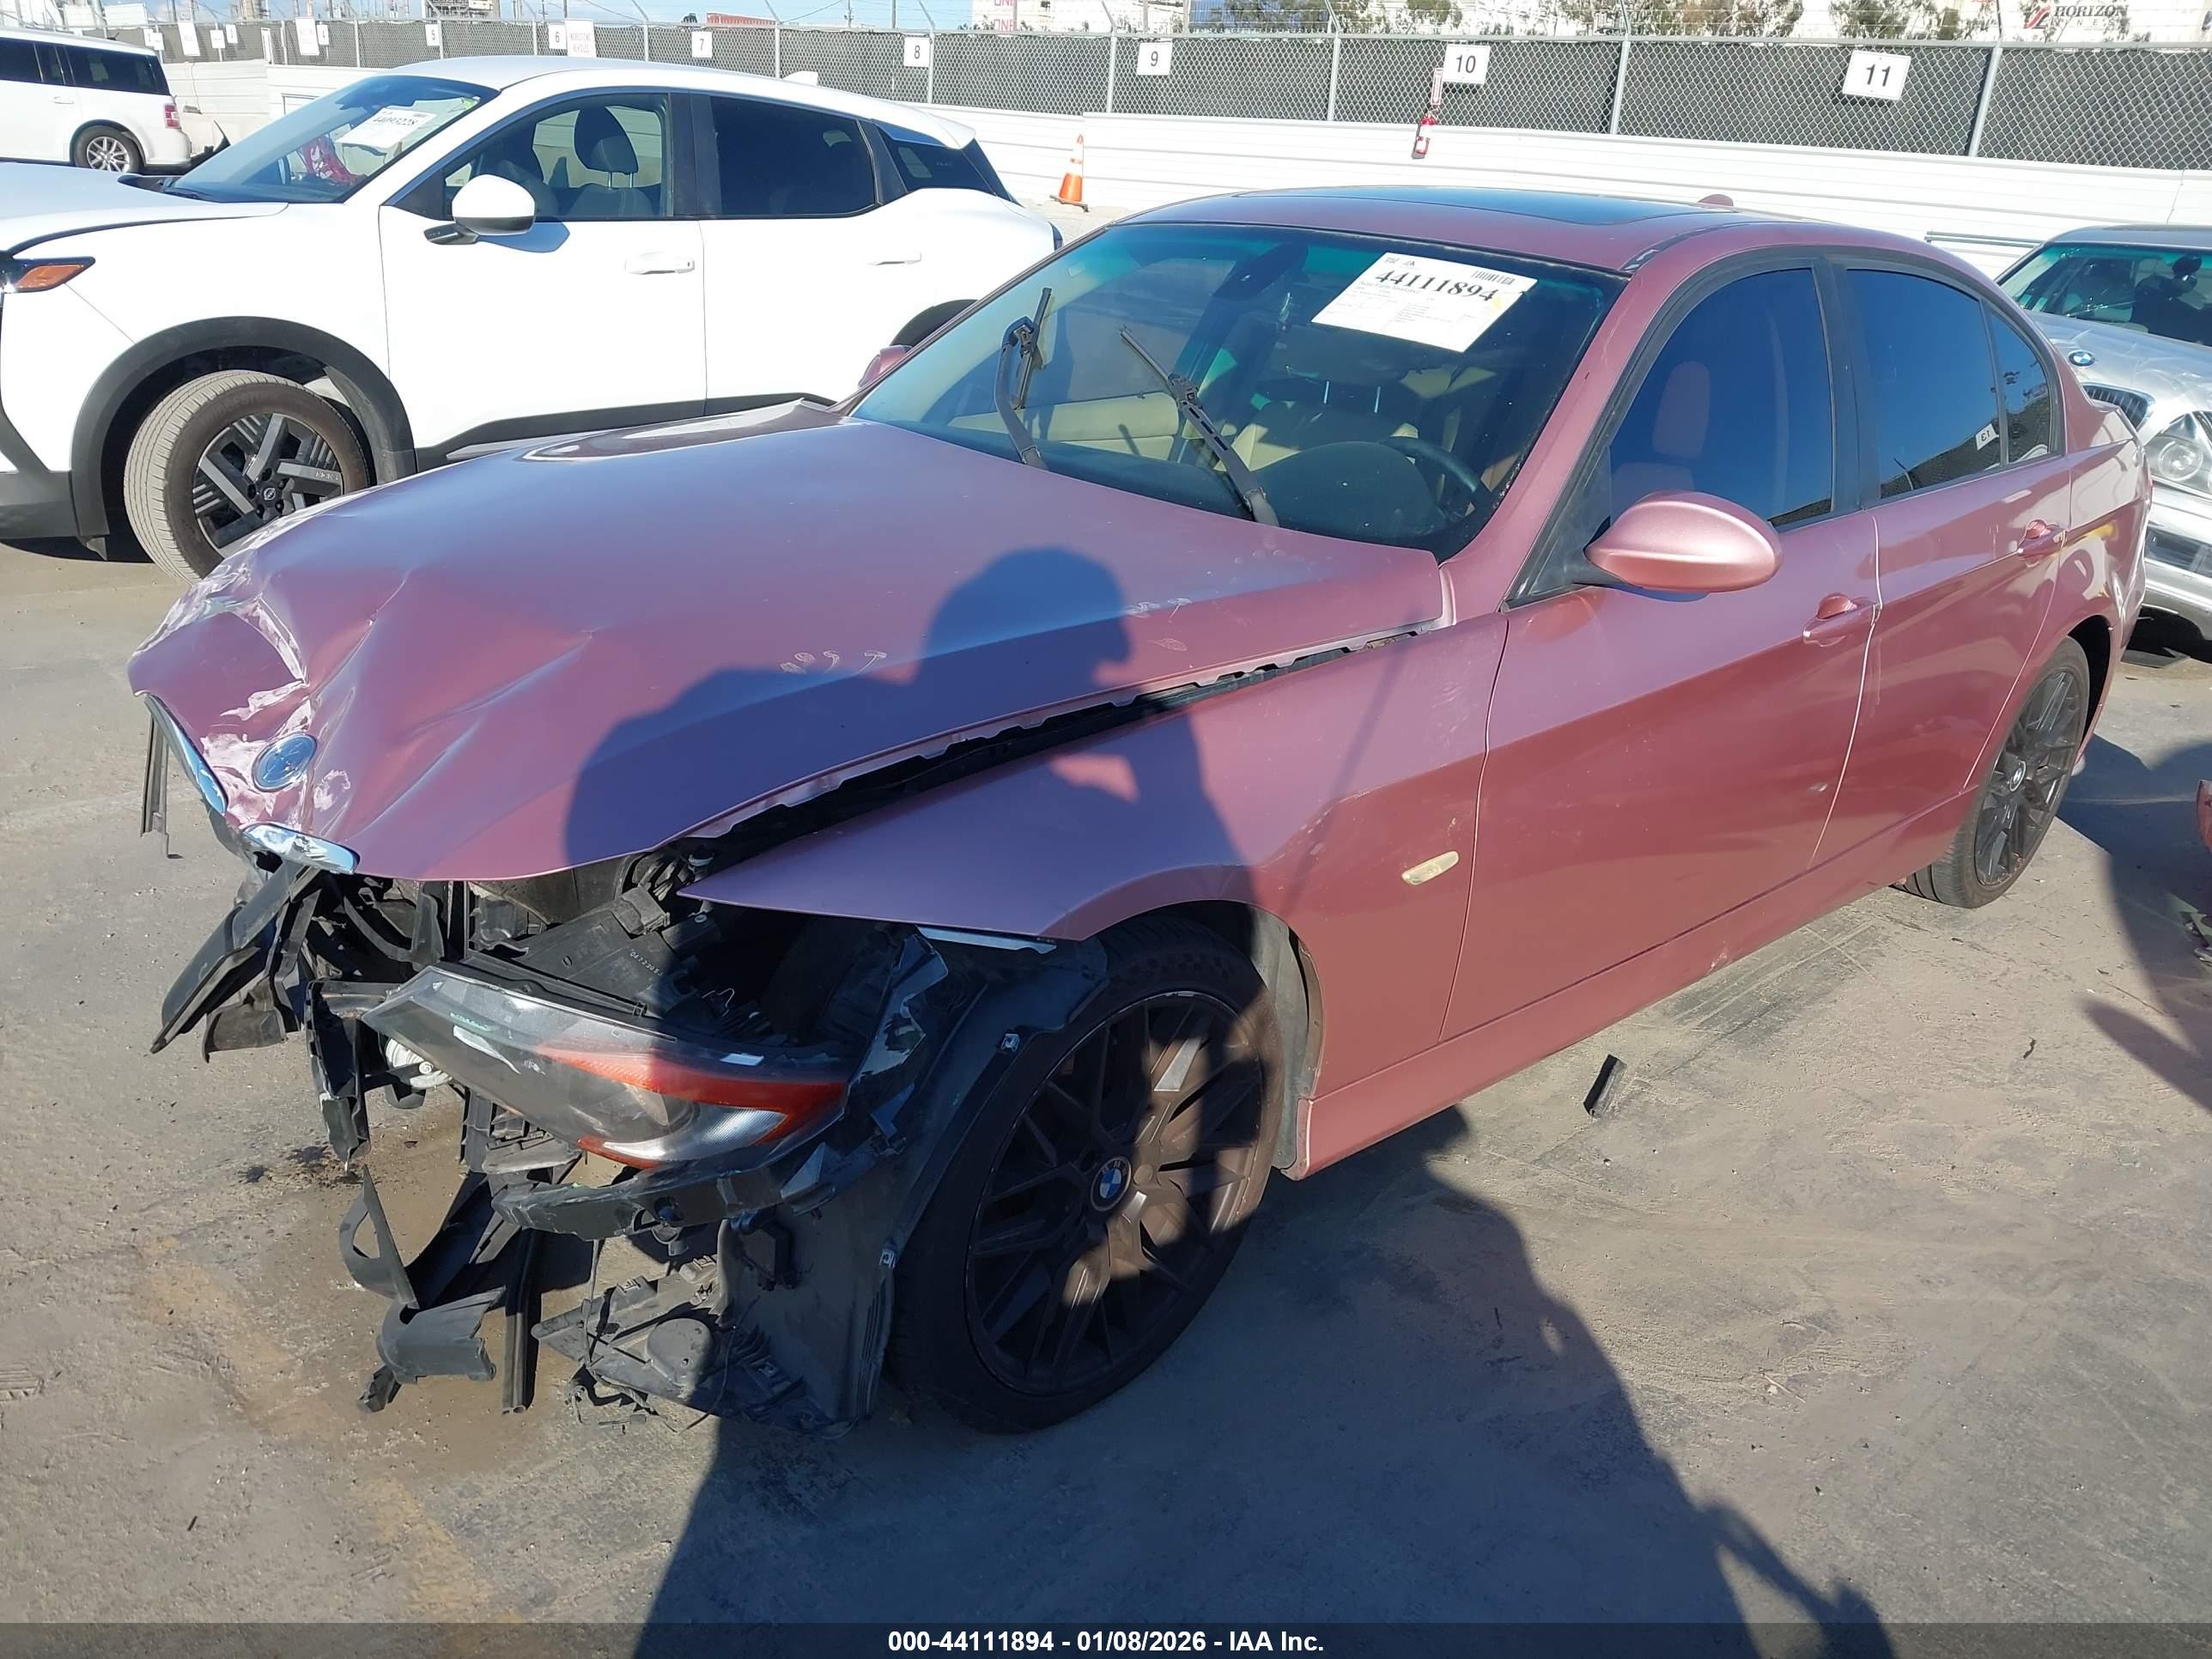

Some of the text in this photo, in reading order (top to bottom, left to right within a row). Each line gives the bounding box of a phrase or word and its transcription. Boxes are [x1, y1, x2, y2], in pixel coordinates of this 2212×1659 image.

[2053, 4, 2130, 17] HORIZON
[431, 29, 436, 40] 5
[555, 31, 560, 43] 6
[699, 38, 705, 52] 7
[914, 45, 921, 59] 8
[1150, 51, 1158, 67] 9
[1455, 54, 1476, 74] 10
[1866, 64, 1892, 88] 11
[1376, 270, 1499, 302] 44111894
